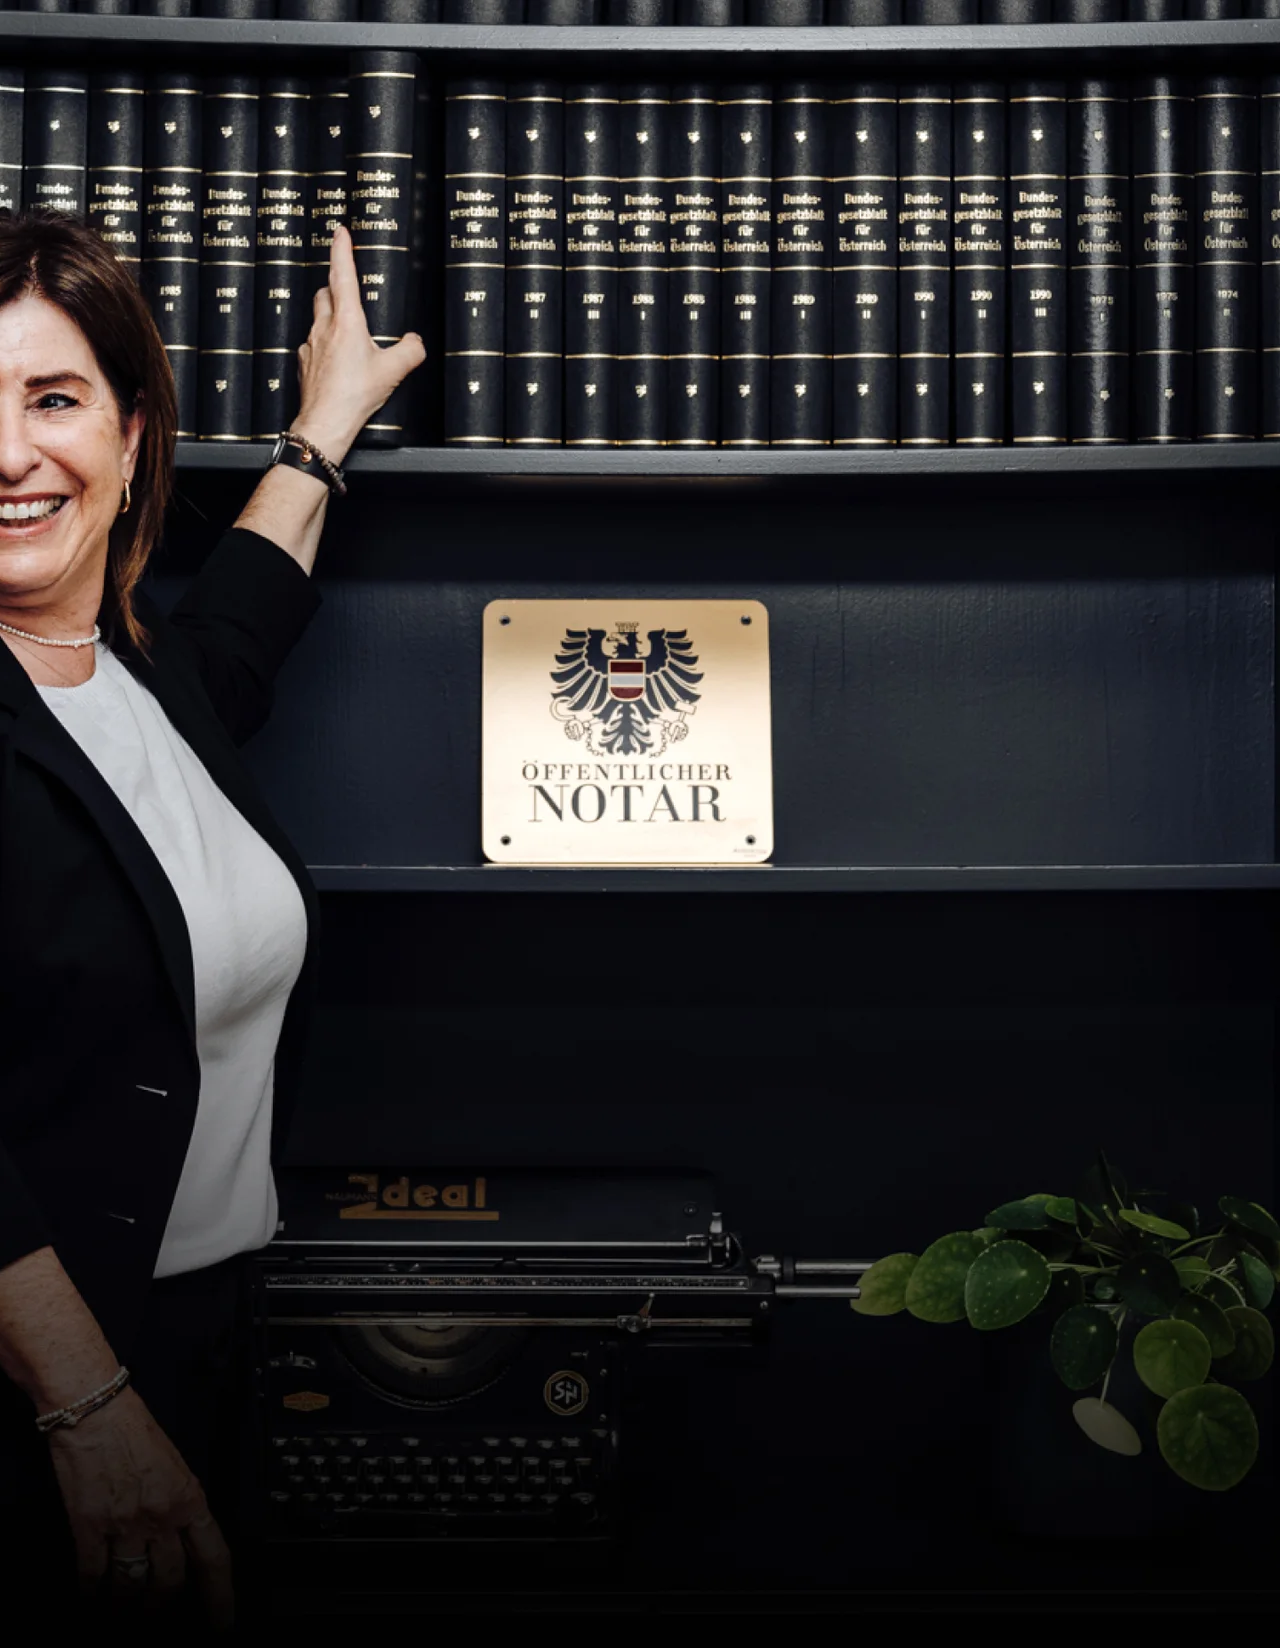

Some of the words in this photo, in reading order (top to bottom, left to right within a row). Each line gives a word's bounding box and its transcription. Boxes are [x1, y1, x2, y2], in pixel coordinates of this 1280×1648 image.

[317, 187, 347, 200] Bunde
[365, 202, 382, 214] für
[161, 215, 178, 227] für
[217, 219, 234, 232] für
[270, 218, 288, 231] für
[466, 221, 483, 234] für
[524, 223, 541, 235] für
[582, 224, 600, 236] für
[634, 225, 651, 237] für
[685, 225, 702, 237] für
[738, 225, 755, 237] für
[792, 224, 809, 236] für
[855, 224, 871, 236] für
[915, 224, 931, 236] für
[970, 223, 987, 236] für
[1030, 222, 1047, 235] für
[521, 760, 732, 780] ÖFFENTLICHER
[528, 784, 727, 823] NOTAR
